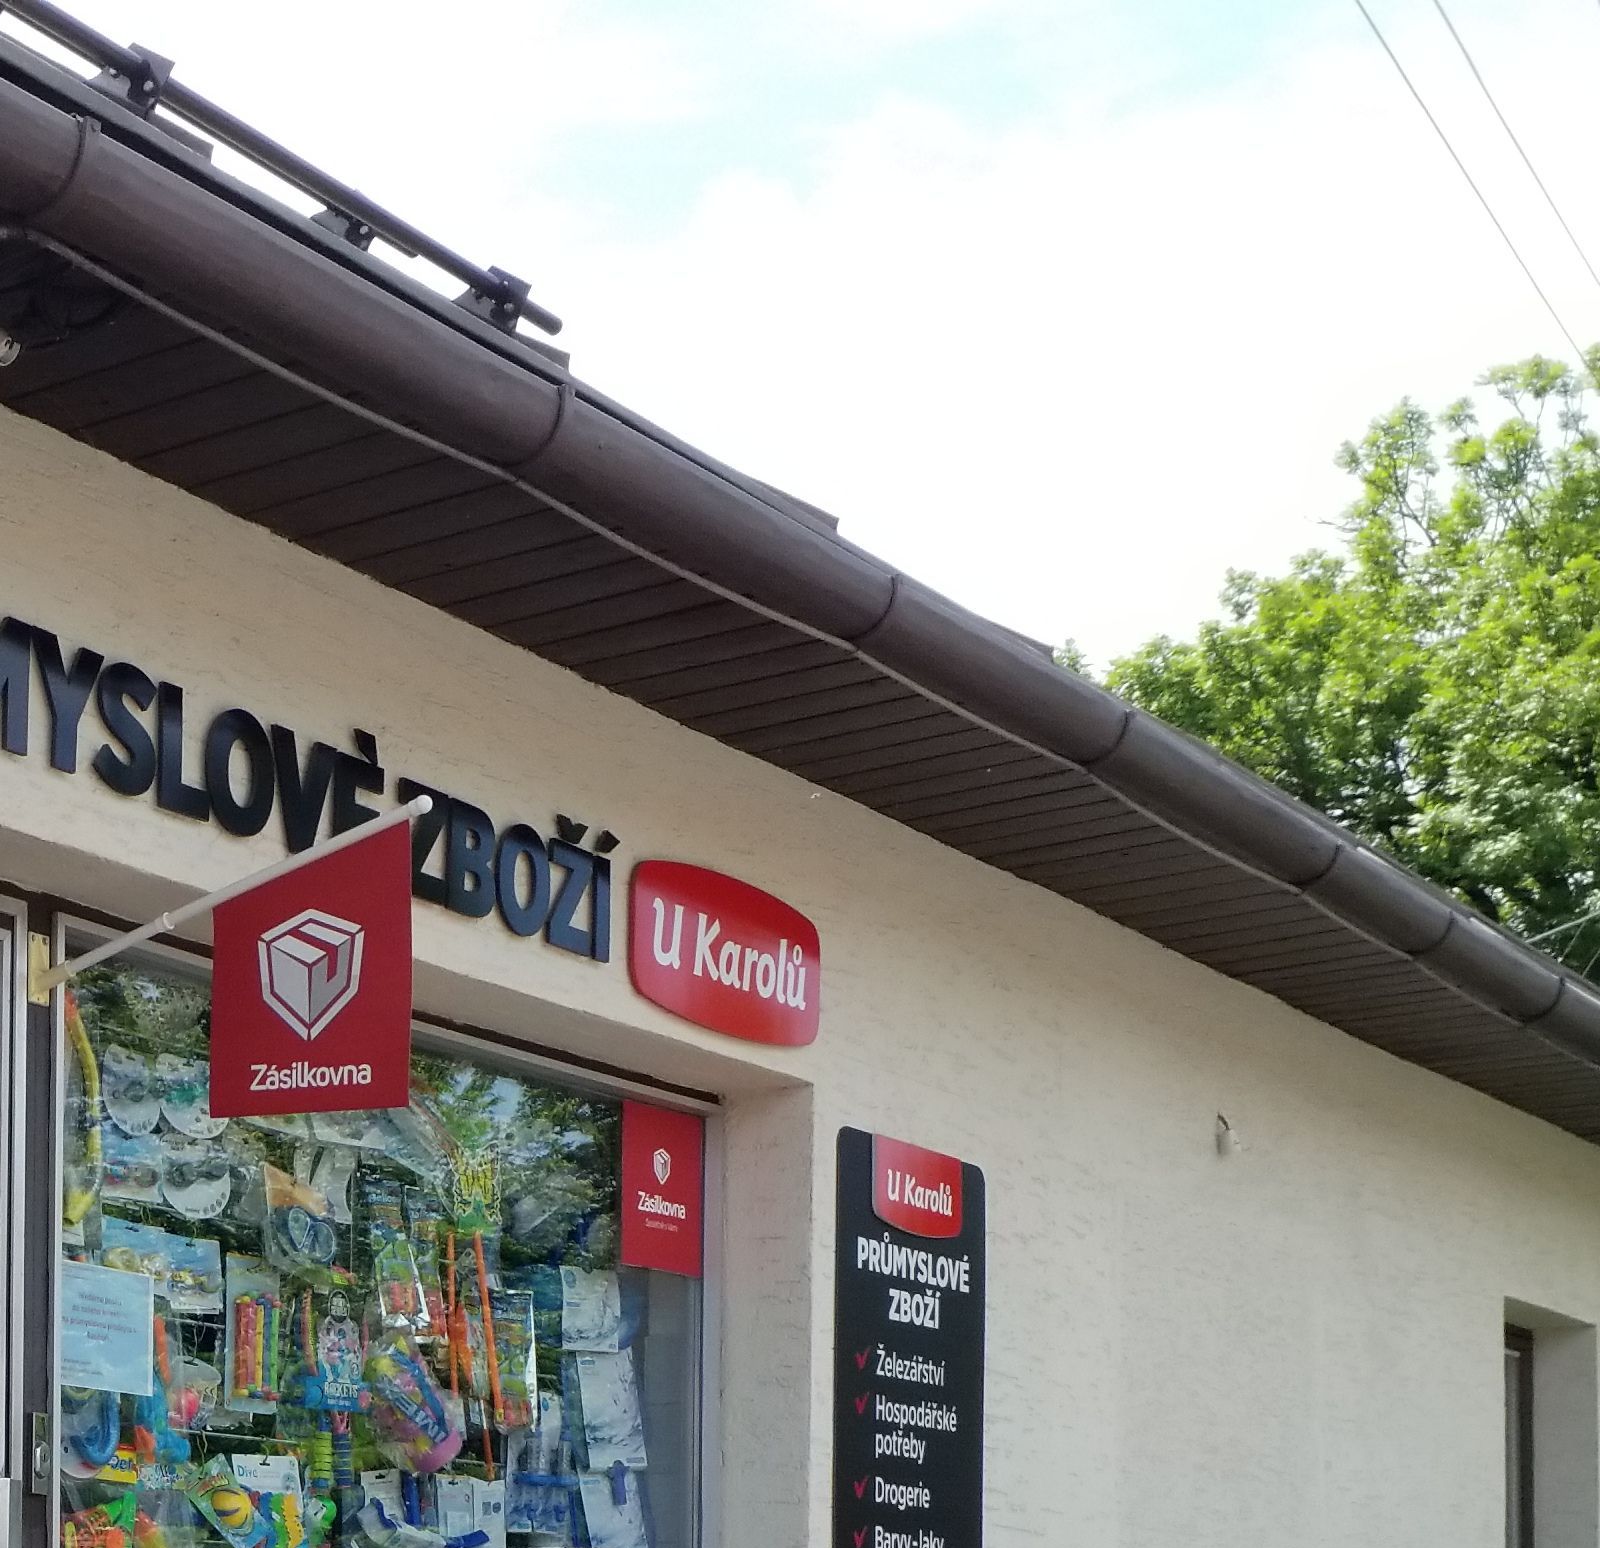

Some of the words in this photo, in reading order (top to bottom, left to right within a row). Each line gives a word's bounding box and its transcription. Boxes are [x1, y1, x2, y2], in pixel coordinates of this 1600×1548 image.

[399, 777, 620, 963] ZBOŽÍ
[653, 897, 685, 970] U
[693, 912, 806, 1011] Karolů
[249, 1061, 373, 1093] Zásilkovna
[637, 1190, 686, 1220] Zásilkovna
[887, 1168, 901, 1202] U
[903, 1174, 953, 1217] Karolů
[857, 1231, 971, 1294] PRŮMYSLOVÉ
[888, 1288, 941, 1330] ZBOŽÍ
[875, 1342, 946, 1387] Železářství
[875, 1394, 958, 1434] Hospodářské
[875, 1431, 927, 1466] potřeby
[874, 1475, 931, 1510] Drogerie
